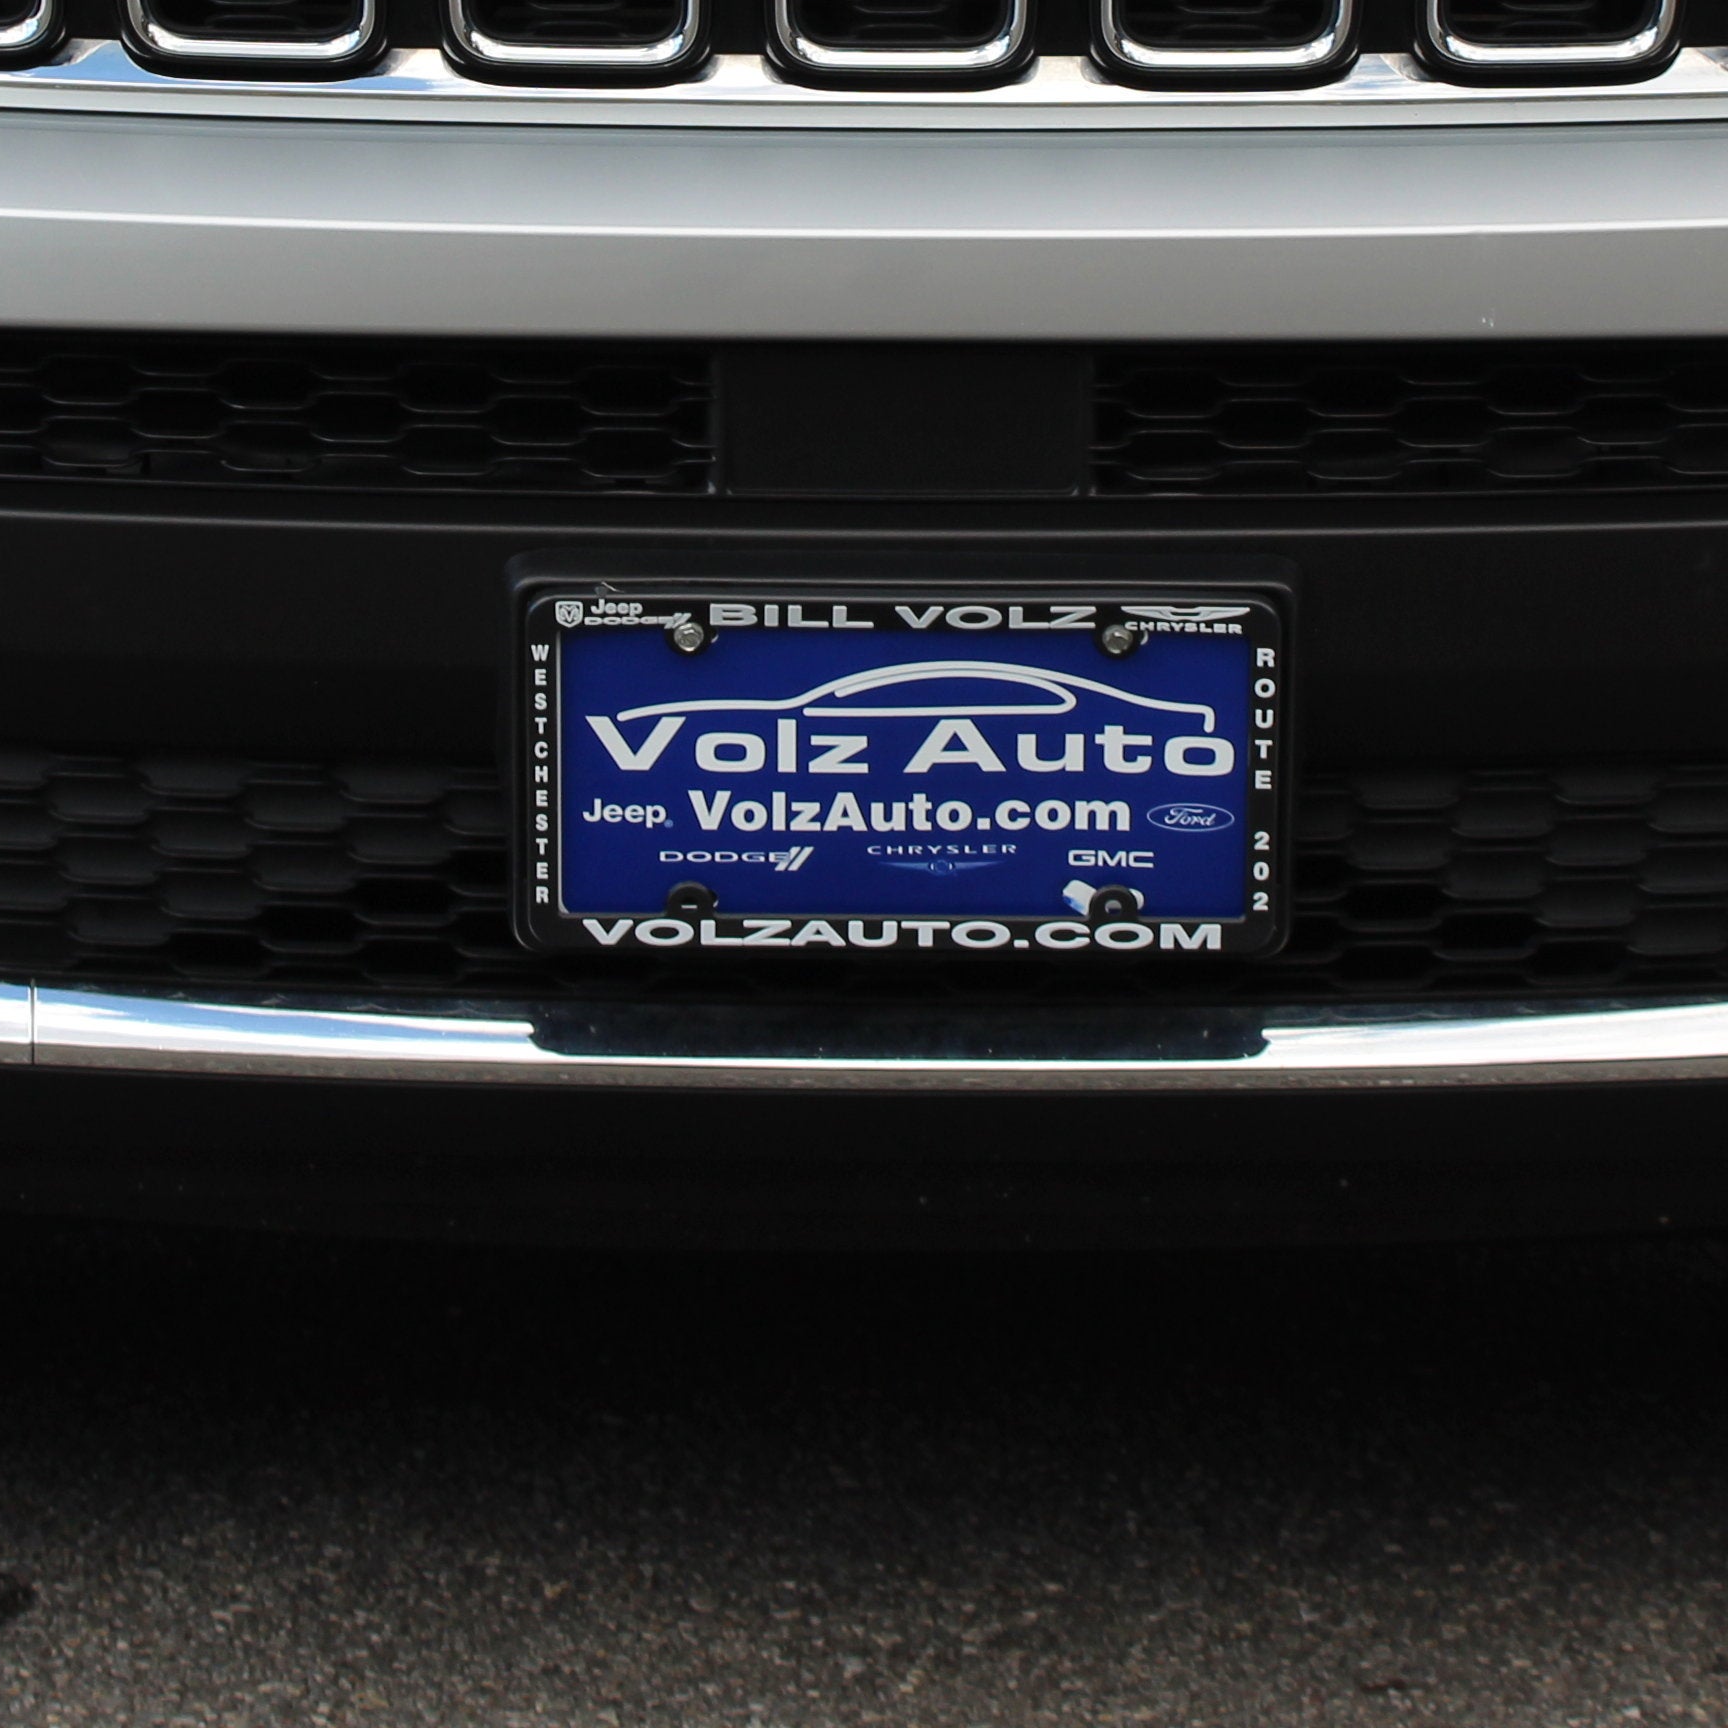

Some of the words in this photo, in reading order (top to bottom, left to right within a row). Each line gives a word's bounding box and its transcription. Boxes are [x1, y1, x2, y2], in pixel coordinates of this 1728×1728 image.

[590, 598, 644, 617] Jeep
[709, 603, 874, 629] BILL
[894, 605, 1097, 630] VOLZ
[1123, 620, 1244, 635] CHRYSLER
[1253, 647, 1276, 790] ROUTE
[584, 714, 870, 774] Volz
[902, 718, 1236, 777] Auto
[530, 643, 550, 904] WESTCHESTER
[582, 798, 667, 829] Jeep
[687, 789, 1131, 832] VolzAuto.com
[1164, 806, 1216, 828] Ford
[659, 850, 792, 864] DODGE
[866, 843, 1018, 856] CHRYSLER
[1067, 849, 1155, 869] GMC
[1252, 830, 1271, 912] 202
[581, 918, 1222, 951] VOLZAUTO.COM
